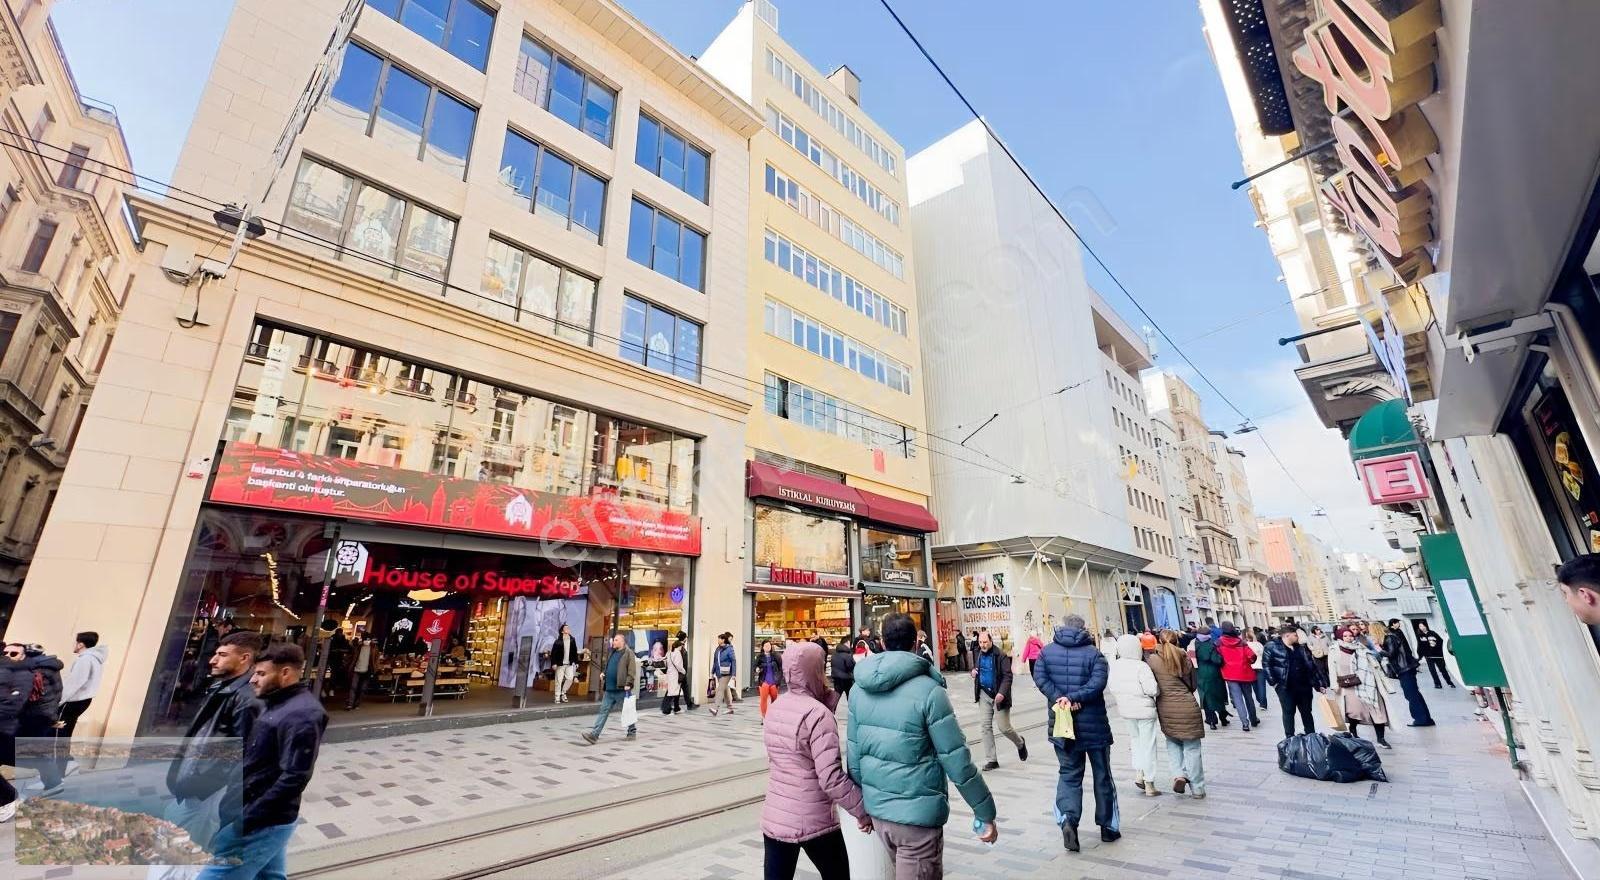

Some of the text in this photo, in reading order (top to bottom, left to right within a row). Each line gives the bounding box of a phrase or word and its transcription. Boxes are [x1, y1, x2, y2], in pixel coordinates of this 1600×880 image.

[297, 470, 305, 479] 4
[1373, 458, 1415, 497] E
[778, 485, 813, 503] İSTİKLAL
[365, 556, 581, 597] House of SuperStep
[962, 596, 986, 610] TERKOS
